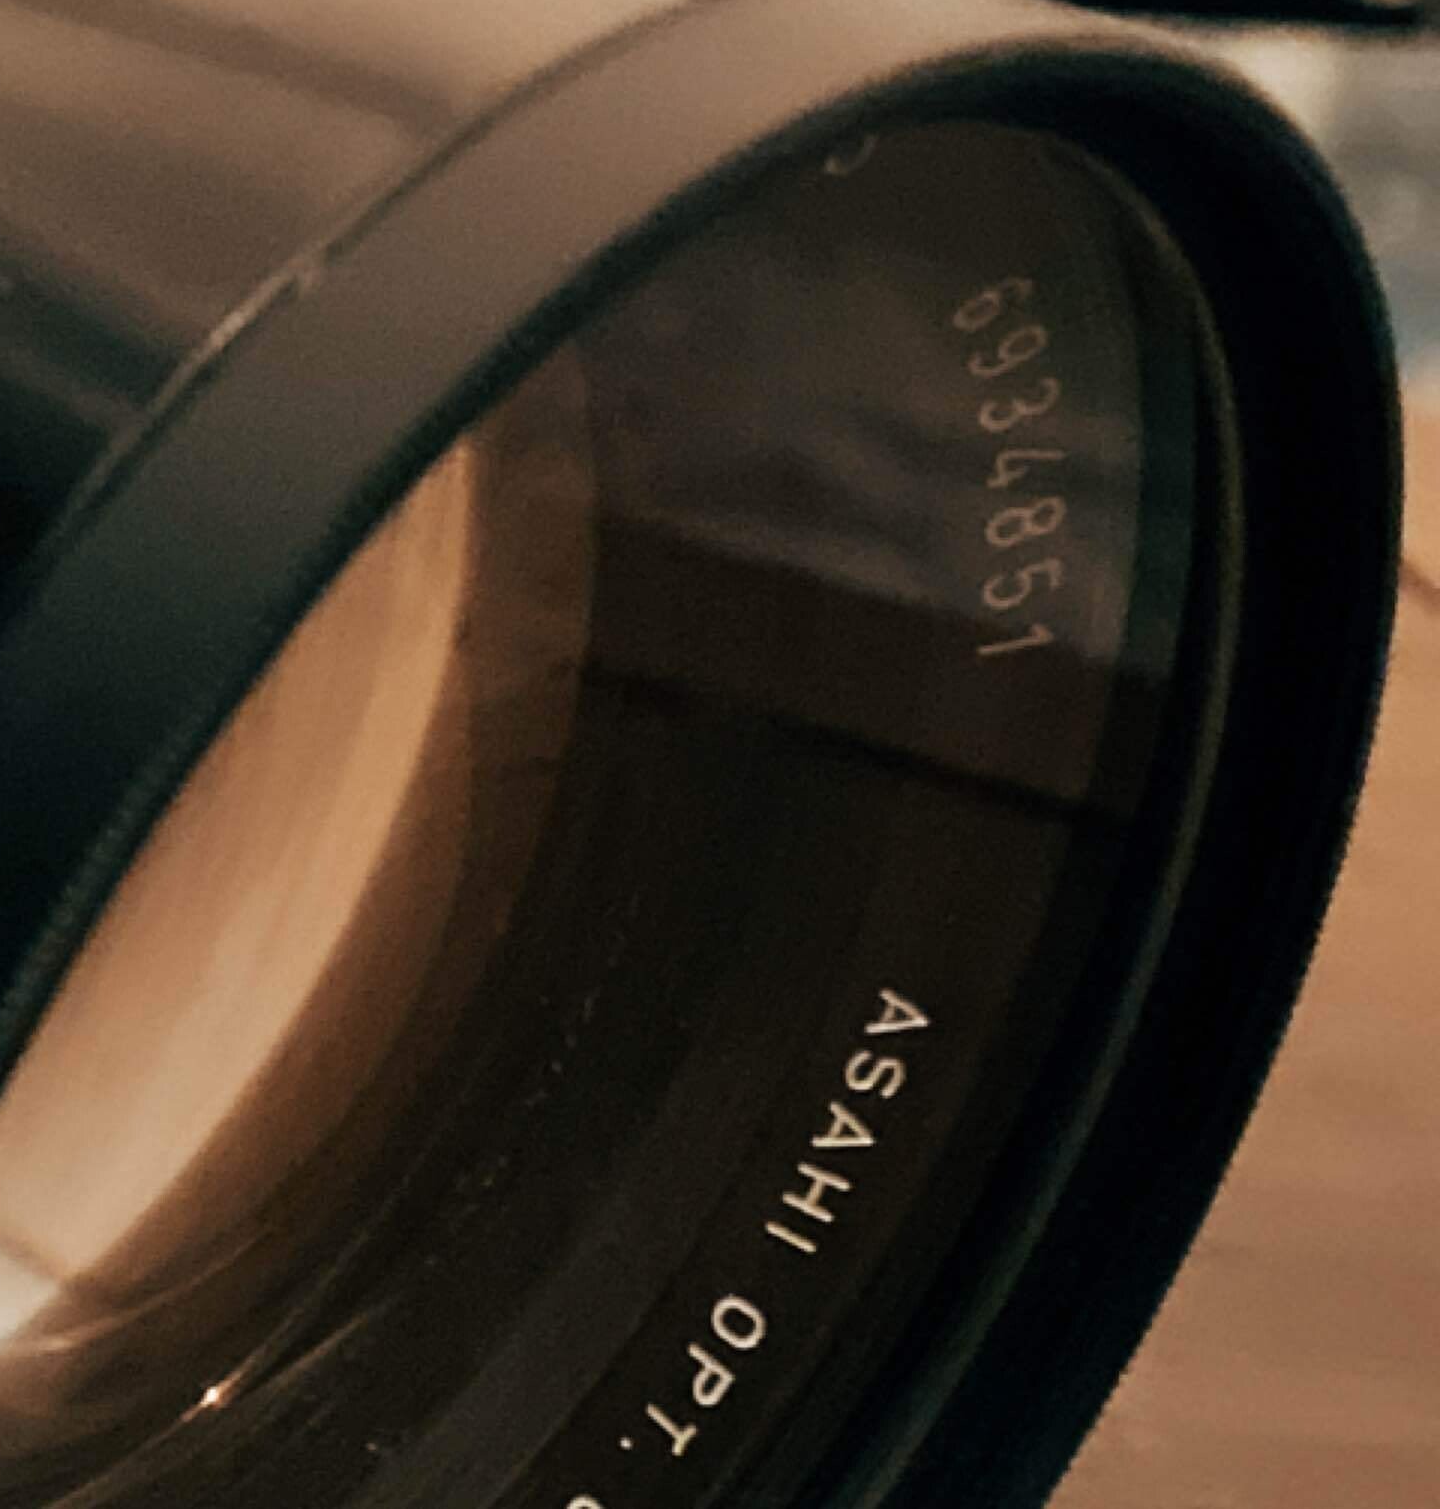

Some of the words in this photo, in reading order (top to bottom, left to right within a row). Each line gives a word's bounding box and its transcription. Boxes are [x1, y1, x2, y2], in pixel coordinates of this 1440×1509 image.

[951, 272, 1067, 659] 6934851
[762, 987, 933, 1255] ASAHI
[618, 1292, 769, 1458] OPT.
